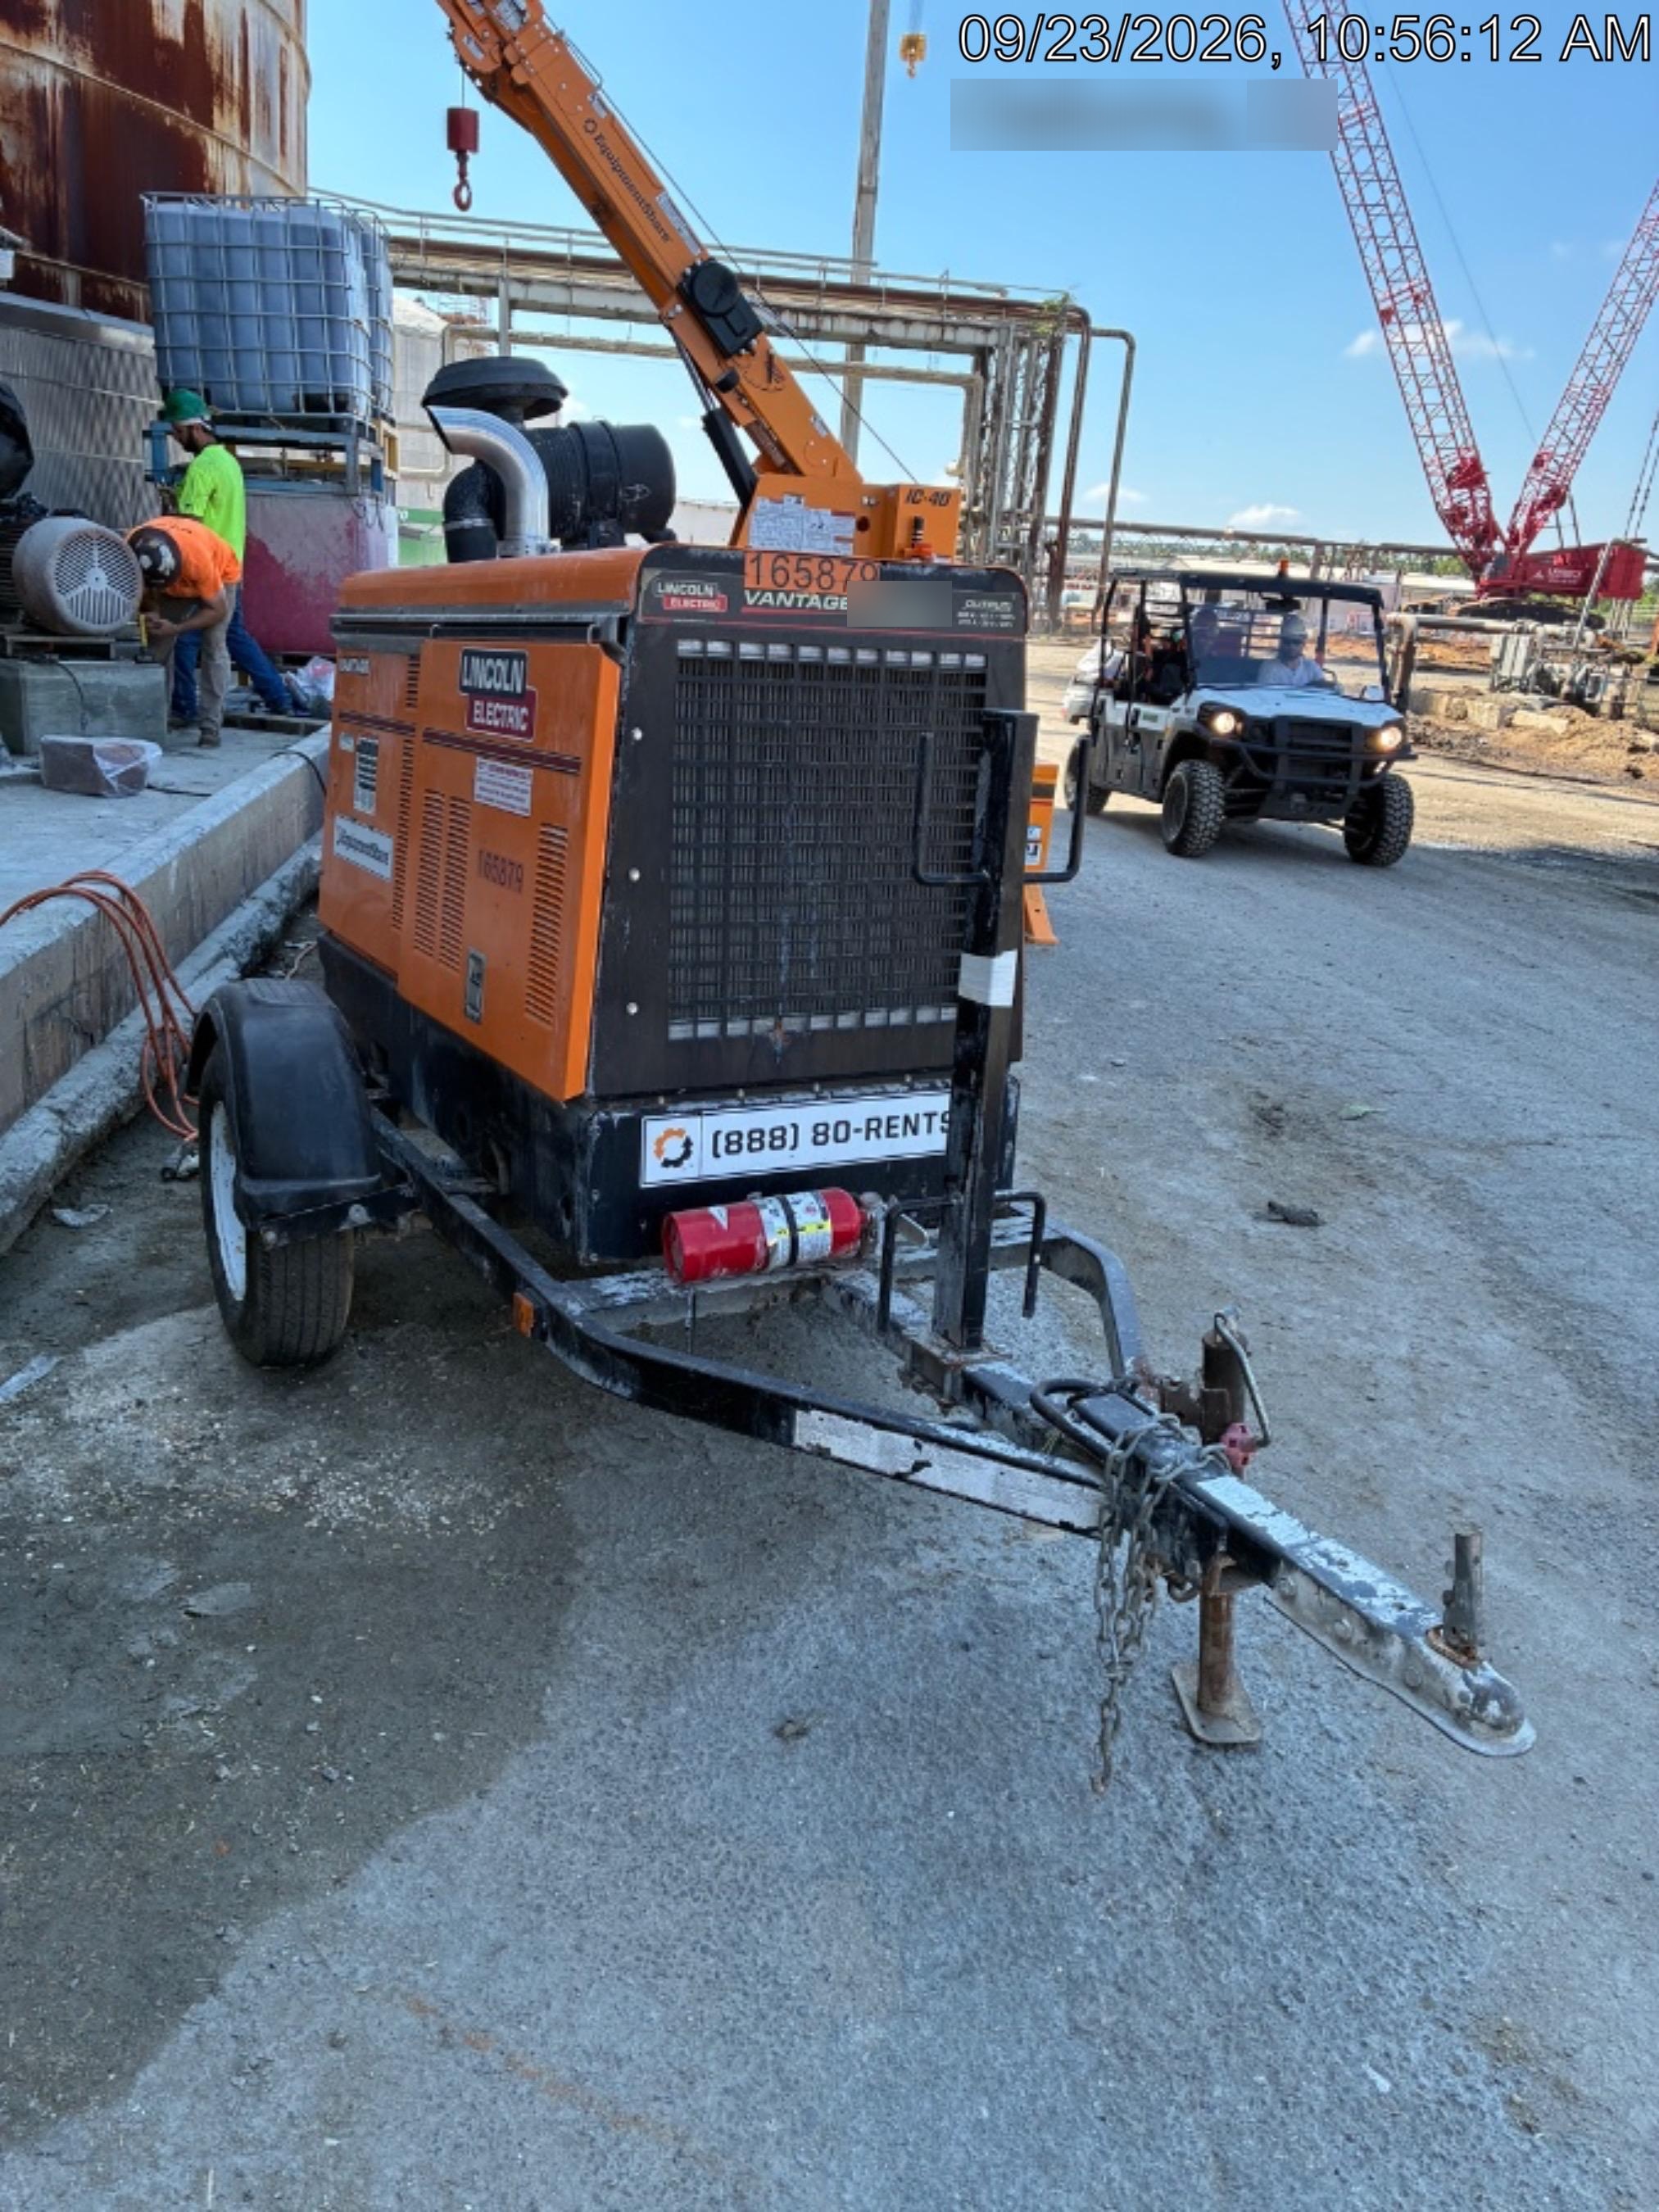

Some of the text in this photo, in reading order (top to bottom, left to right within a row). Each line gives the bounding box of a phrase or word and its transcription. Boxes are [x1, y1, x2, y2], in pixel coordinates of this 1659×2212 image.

[657, 581, 714, 598] LINCOLN
[462, 655, 525, 694] LINCOLN
[474, 700, 529, 732] ELECTRIC
[478, 849, 524, 894] 165879
[712, 1122, 800, 1158] (888)
